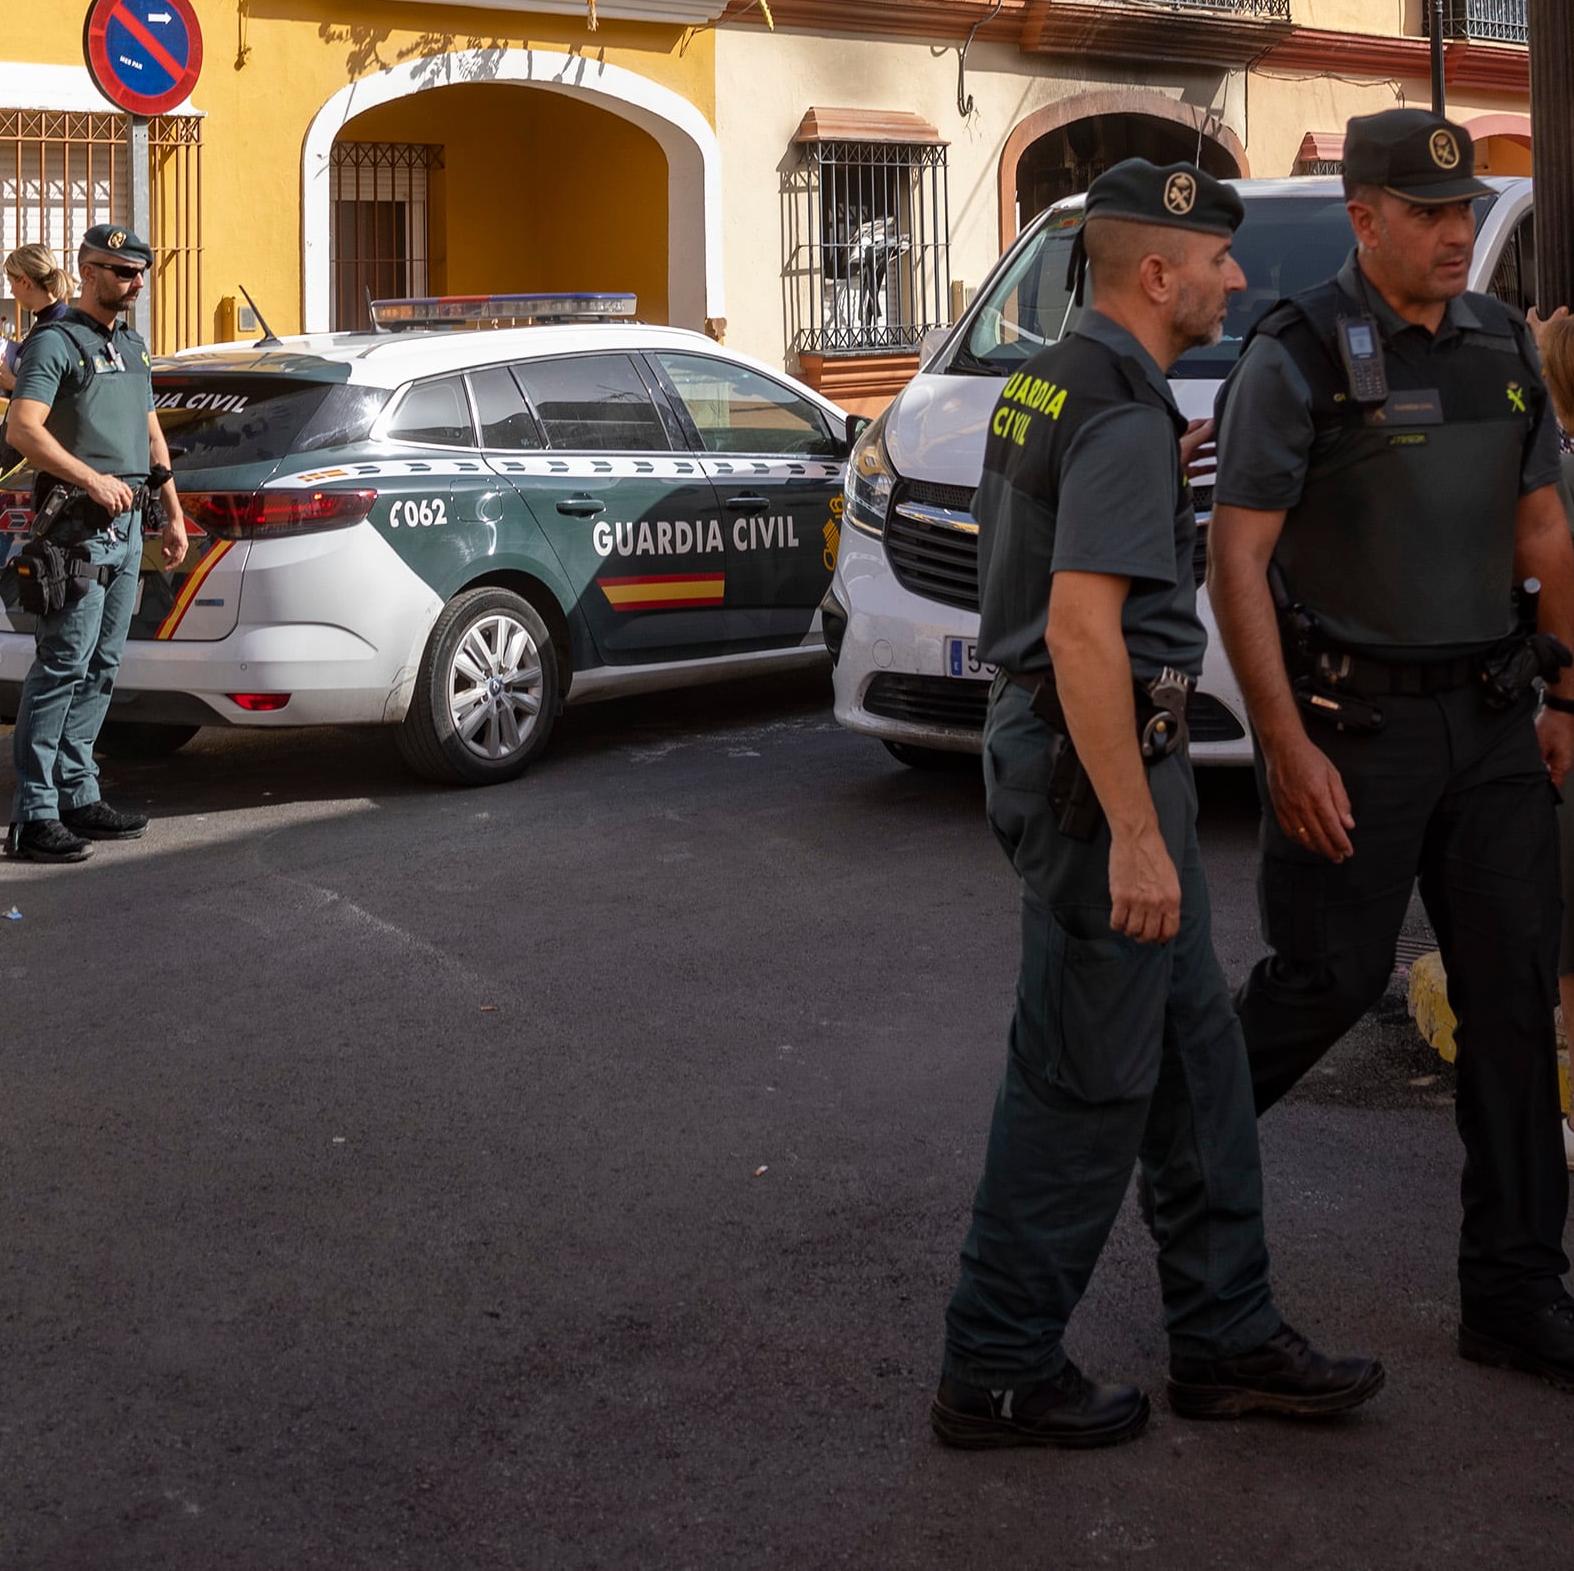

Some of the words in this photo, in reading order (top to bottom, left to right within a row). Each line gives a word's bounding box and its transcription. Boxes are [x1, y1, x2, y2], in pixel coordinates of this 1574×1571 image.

[186, 393, 249, 414] CIVIL
[993, 406, 1032, 446] CIVIL
[404, 498, 448, 528] 062
[592, 519, 724, 557] GUARDIA
[732, 515, 799, 551] CIVIL
[967, 644, 997, 675] 5
